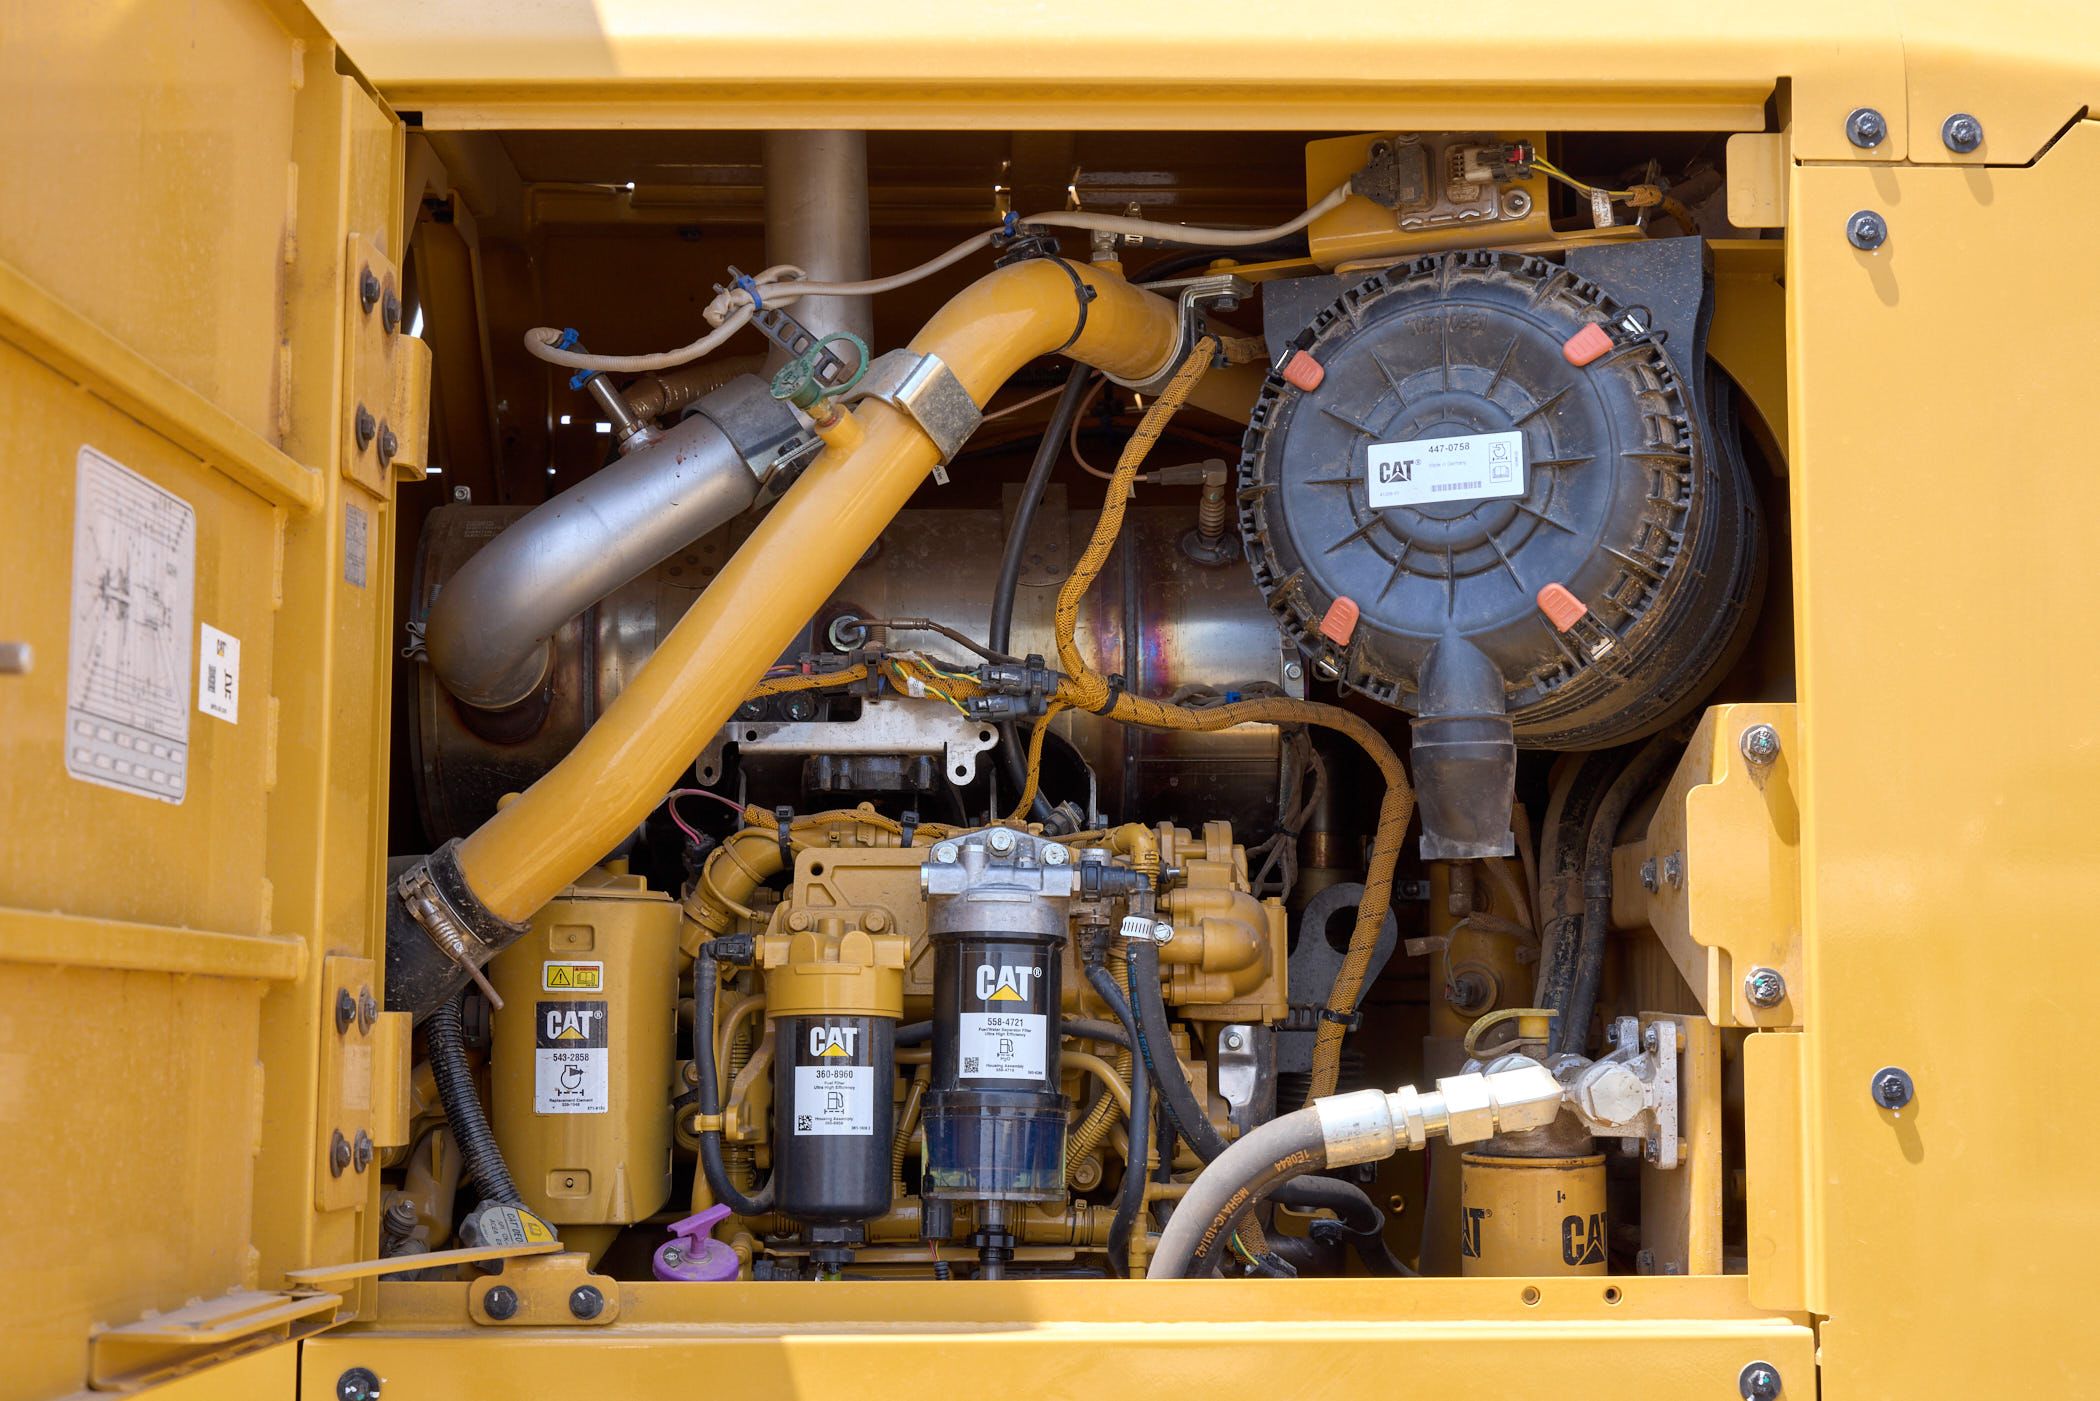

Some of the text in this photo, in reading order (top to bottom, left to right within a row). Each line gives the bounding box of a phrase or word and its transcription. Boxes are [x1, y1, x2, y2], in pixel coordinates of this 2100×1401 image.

[1428, 442, 1470, 453] 447-0758
[987, 1017, 1023, 1027] 558-4721
[810, 1026, 857, 1056] CAT
[816, 1070, 854, 1079] 360-8960
[1274, 1149, 1311, 1173] 1E0844
[1221, 1187, 1250, 1217] MSHA
